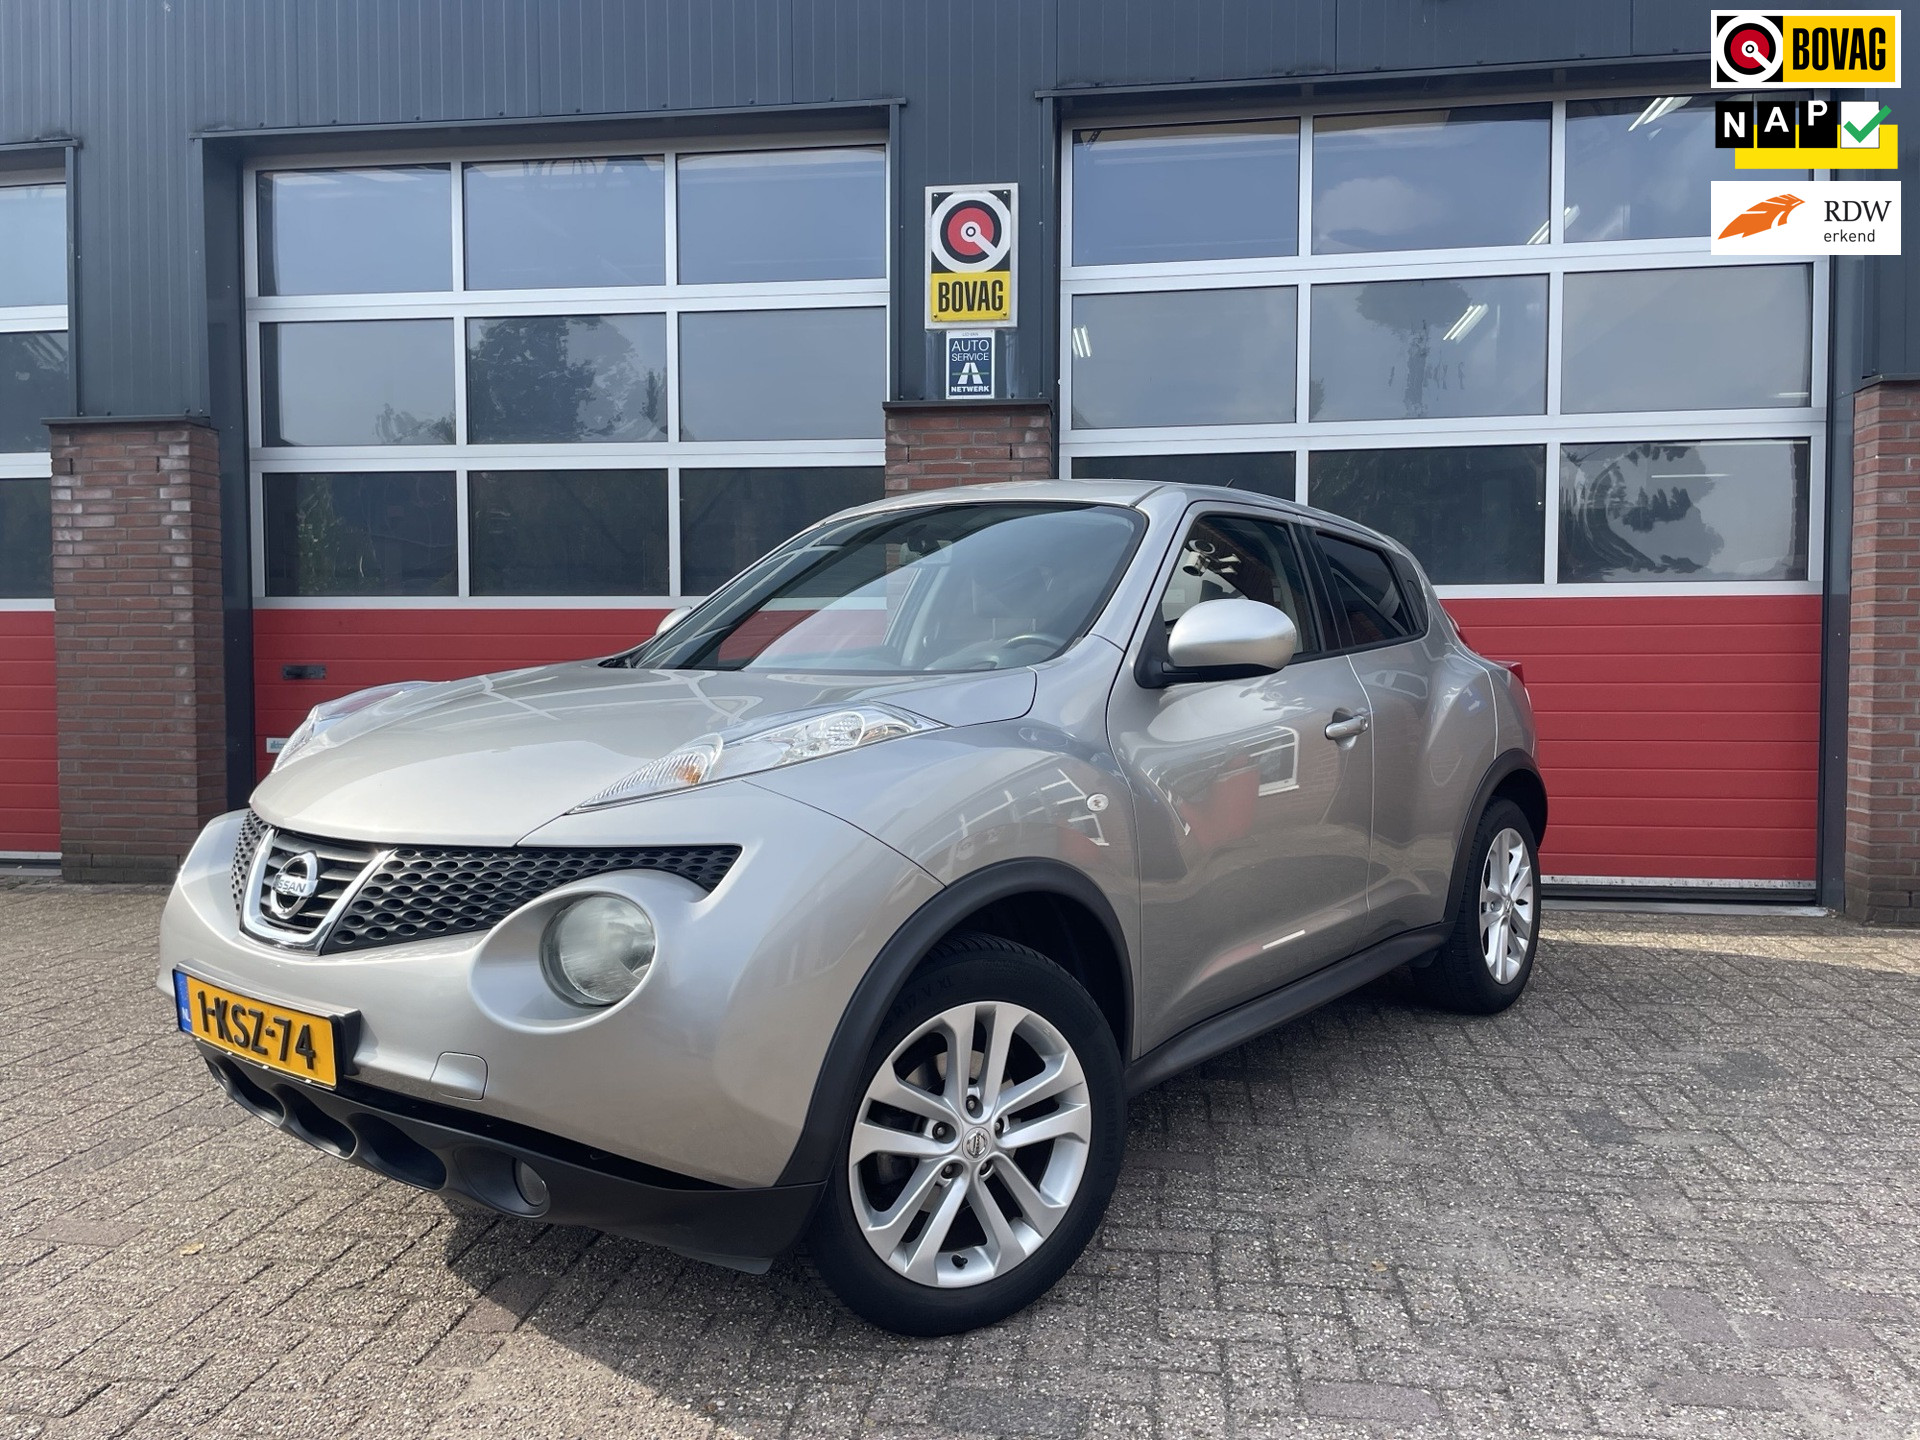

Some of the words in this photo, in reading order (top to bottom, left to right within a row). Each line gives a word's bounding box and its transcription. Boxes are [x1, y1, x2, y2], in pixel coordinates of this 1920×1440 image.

[938, 279, 1003, 312] BOVAG
[951, 339, 990, 352] AUTO
[951, 352, 990, 362] SERVICE
[951, 385, 990, 393] NETWERK
[181, 1006, 191, 1022] NL
[197, 990, 317, 1070] 1-KSZ-74
